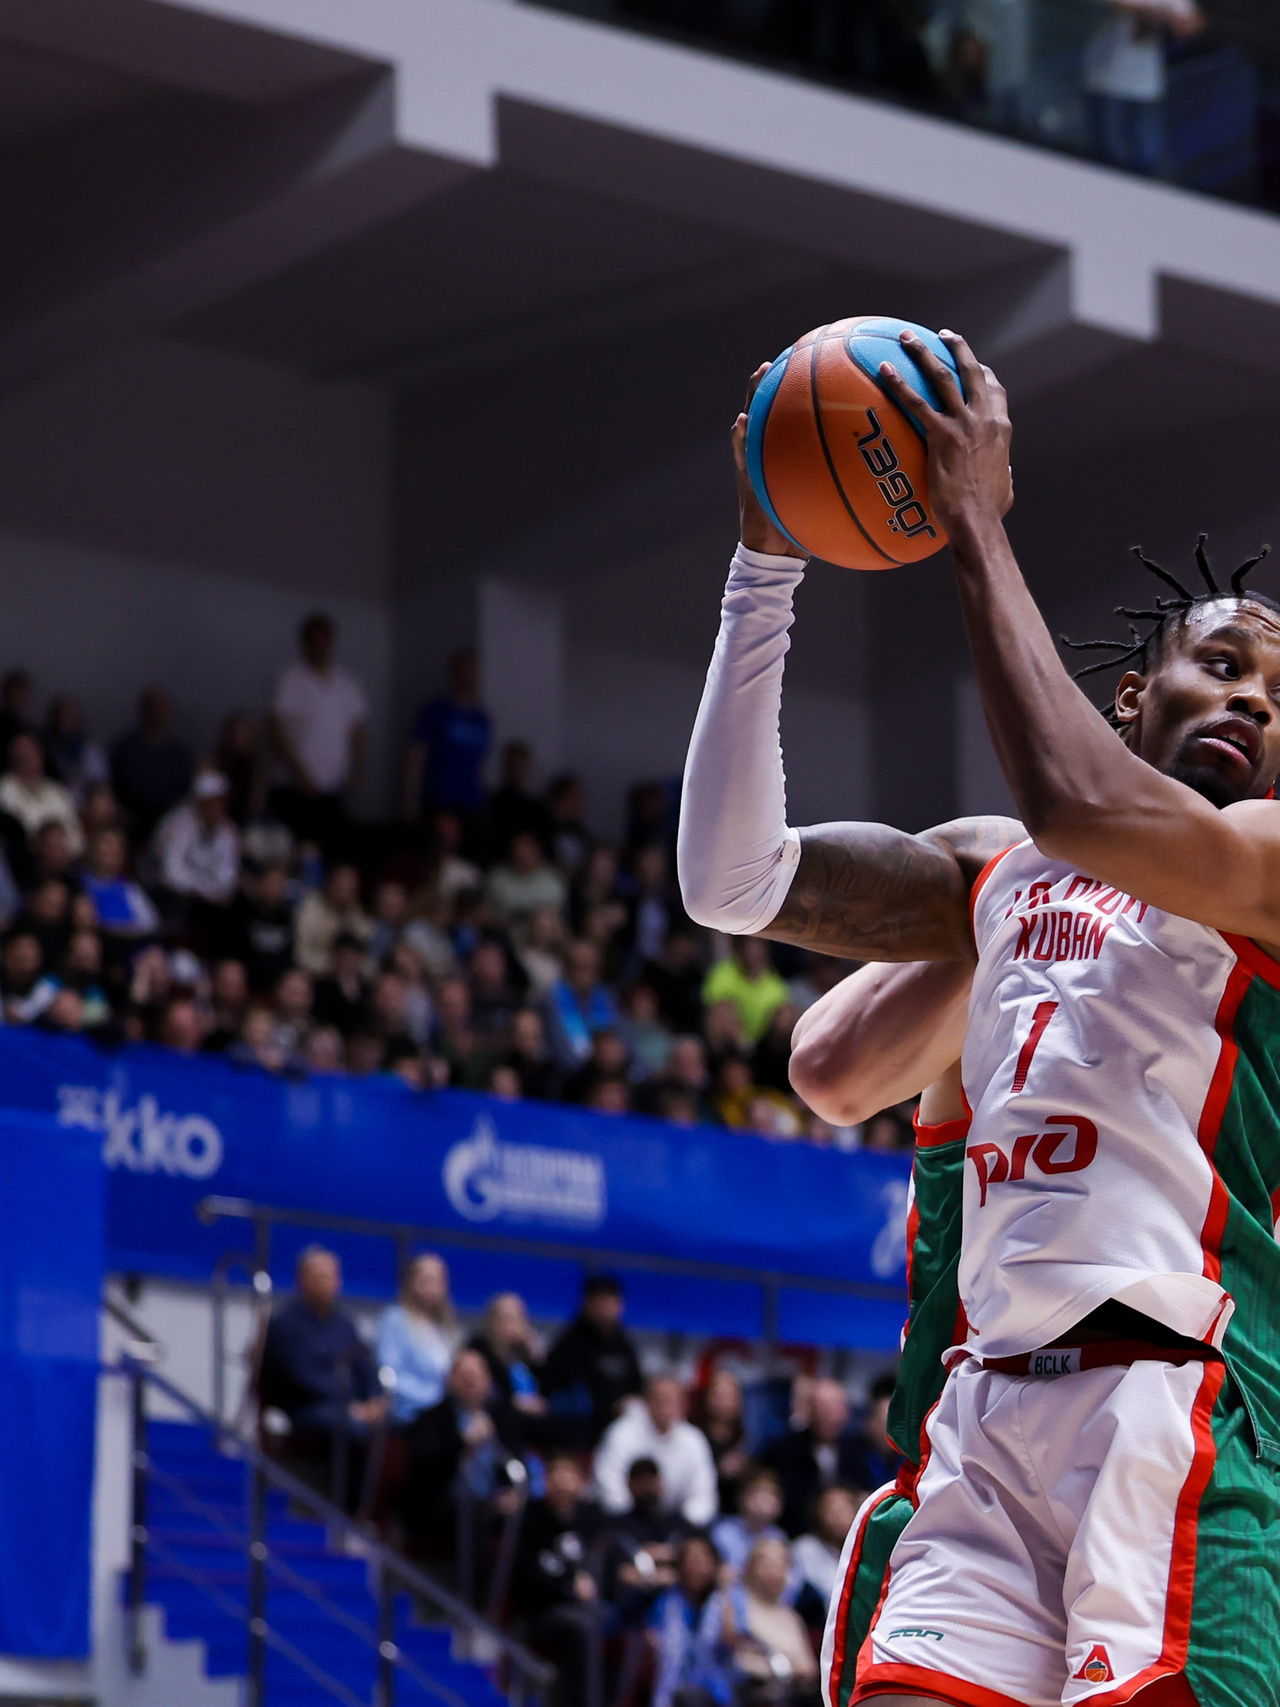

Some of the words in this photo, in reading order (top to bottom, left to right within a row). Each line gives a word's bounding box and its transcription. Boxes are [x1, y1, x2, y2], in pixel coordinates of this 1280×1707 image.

[857, 407, 937, 538] JÖGEL
[1013, 912, 1115, 961] KUBAN
[1010, 1001, 1058, 1094] 1
[1035, 1355, 1070, 1374] BCLK
